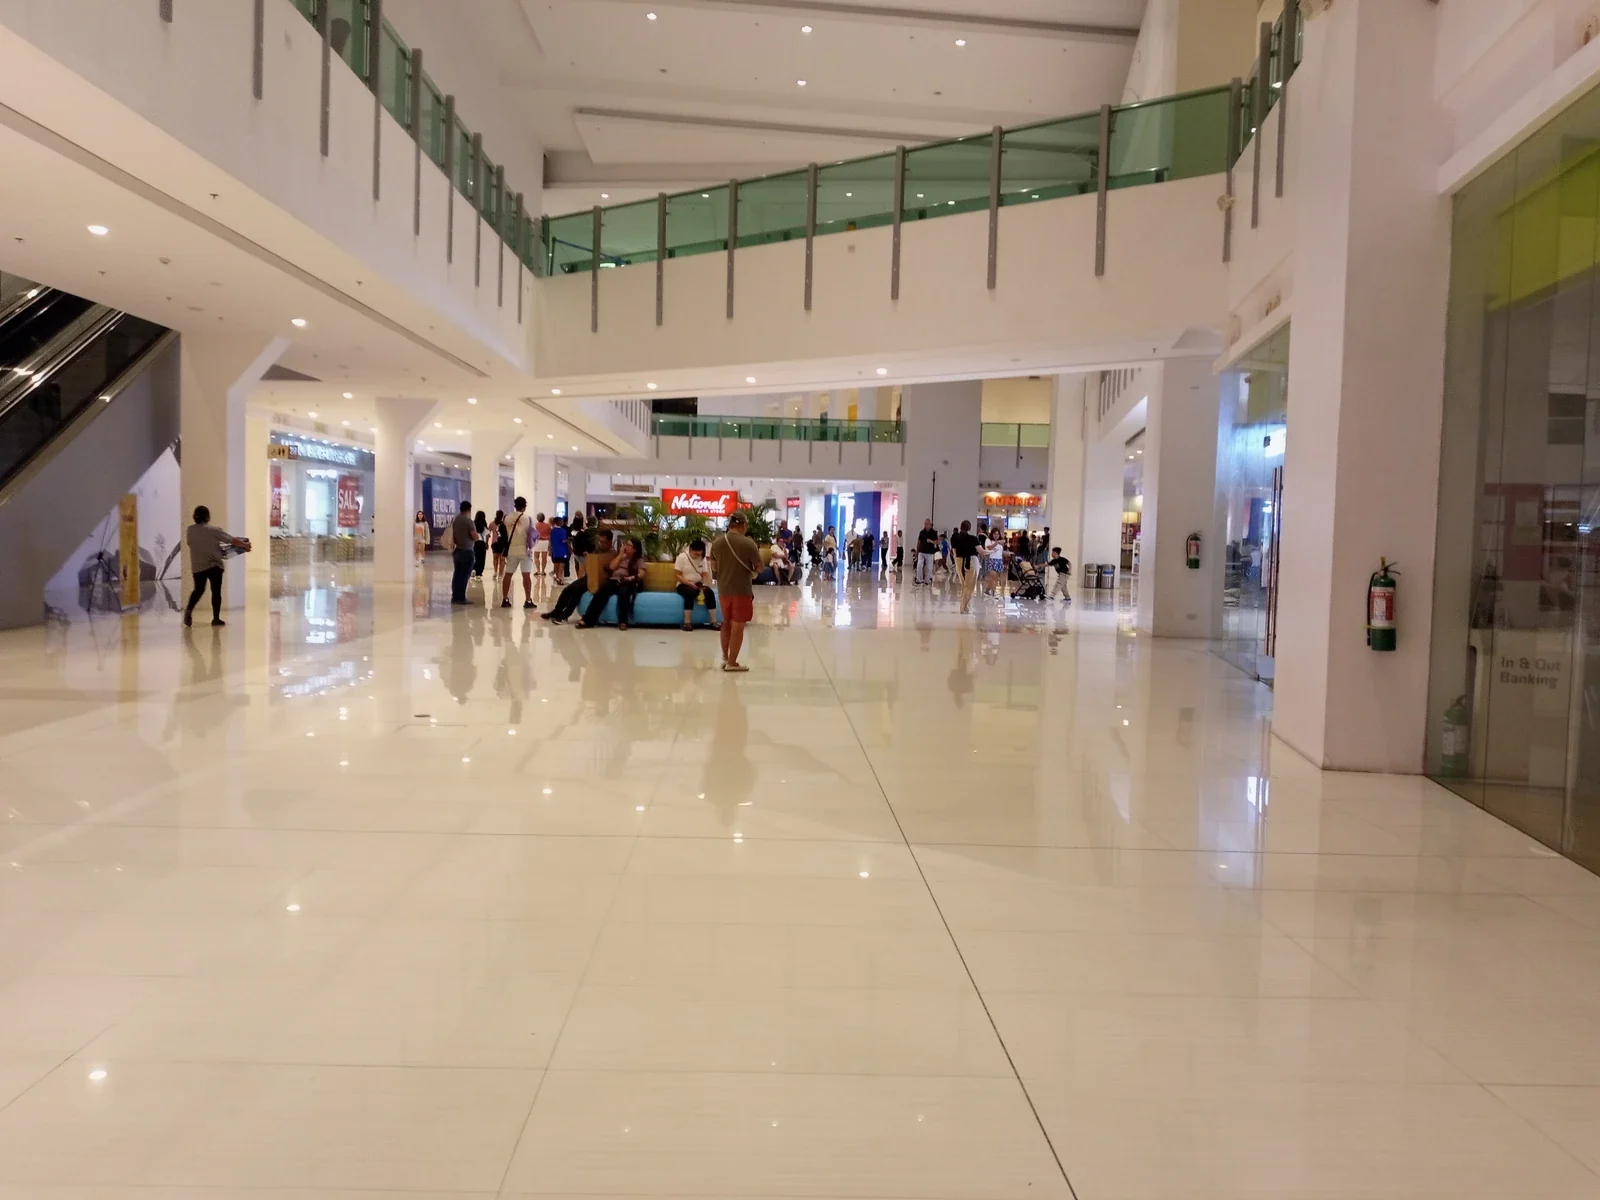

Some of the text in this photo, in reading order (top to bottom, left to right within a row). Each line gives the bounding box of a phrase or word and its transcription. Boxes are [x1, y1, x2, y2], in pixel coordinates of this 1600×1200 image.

[671, 493, 726, 510] National
[1501, 656, 1561, 672] In & Out
[1500, 671, 1559, 689] Banking
